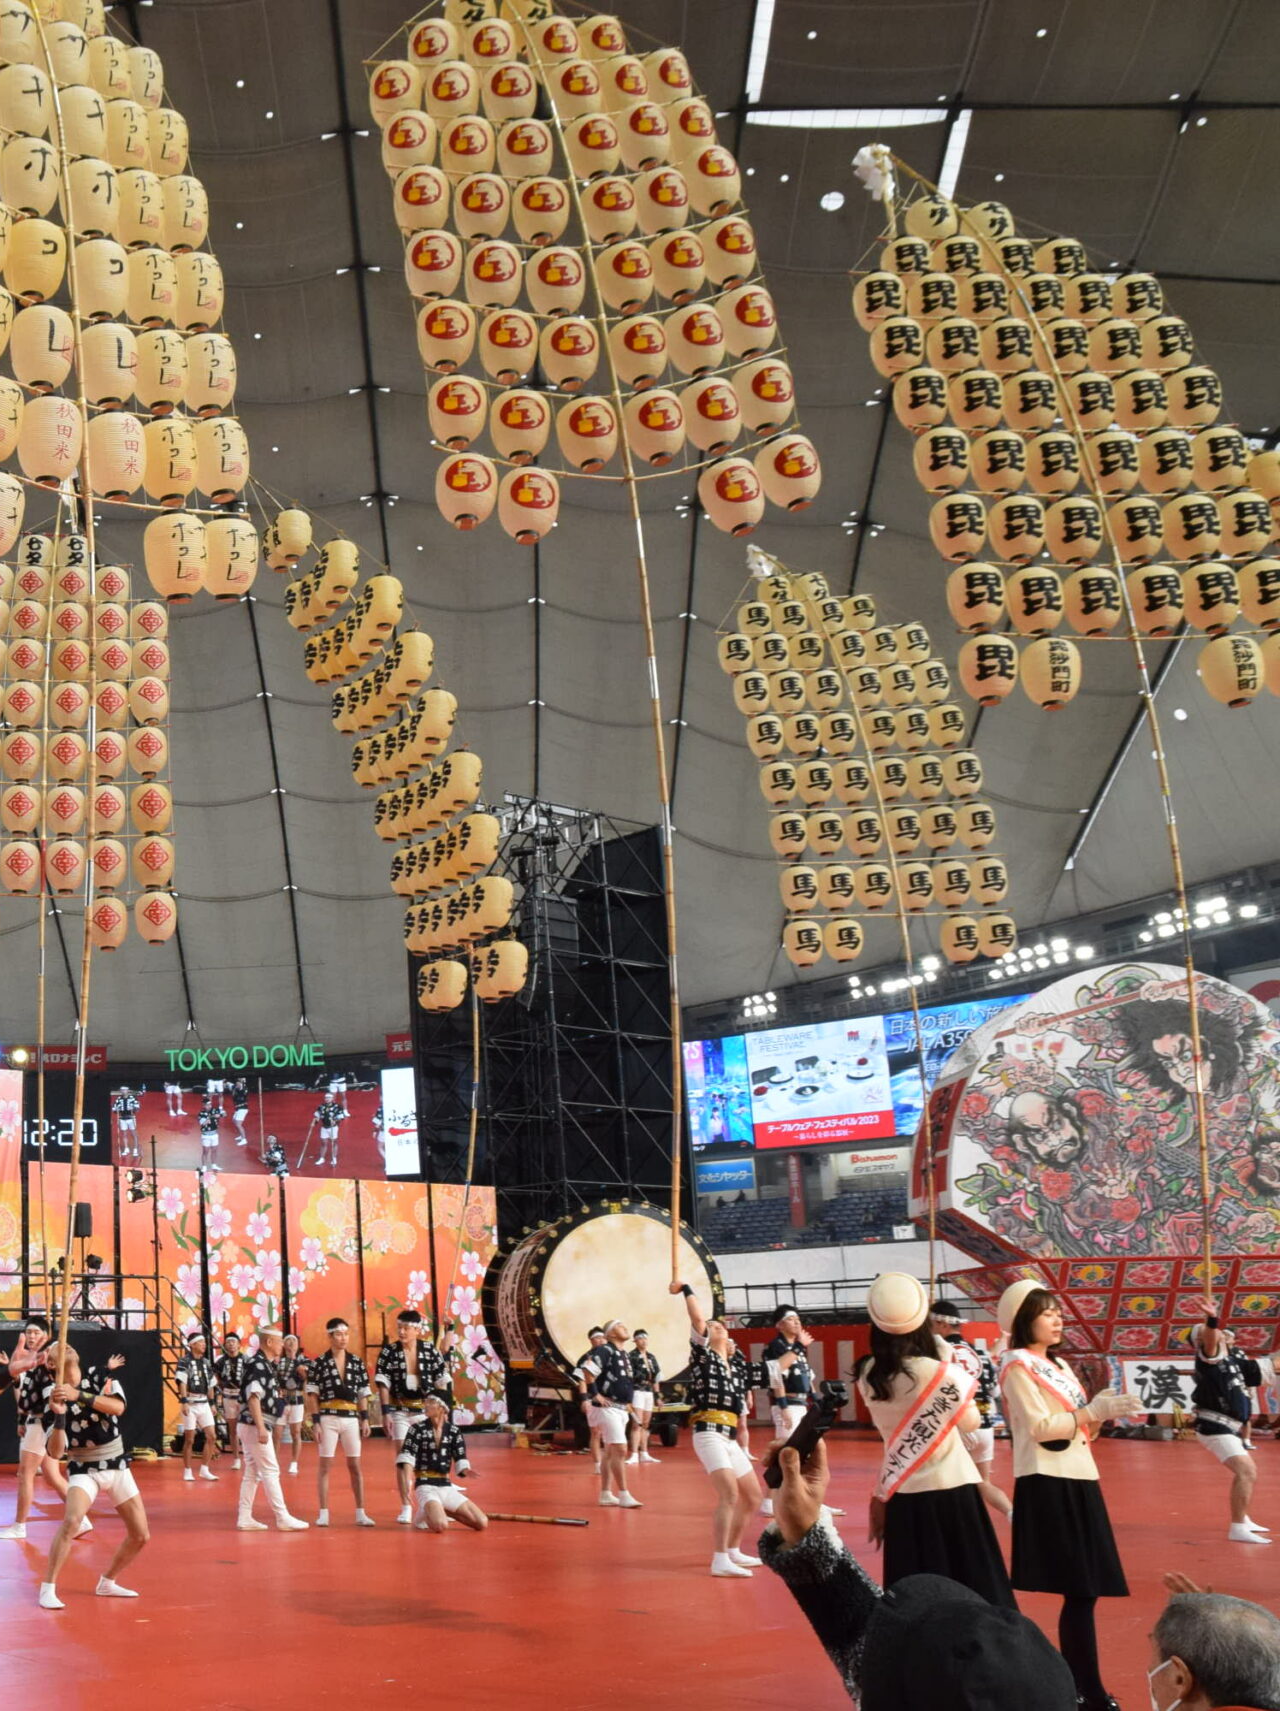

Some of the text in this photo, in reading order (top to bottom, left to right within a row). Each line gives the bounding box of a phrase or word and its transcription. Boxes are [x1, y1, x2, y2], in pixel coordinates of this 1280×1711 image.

[55, 402, 77, 461] 秋田米
[121, 418, 141, 476] 秋田米
[762, 638, 787, 662] 馬
[1048, 641, 1071, 693] 毘沙門町
[1230, 639, 1258, 691] 毘沙門町
[742, 677, 768, 701] 馬
[778, 676, 803, 700] 馬
[756, 721, 782, 745] 馬
[829, 718, 855, 742] 馬
[770, 768, 796, 791] 馬
[807, 767, 833, 792] 馬
[817, 819, 843, 842] 馬
[855, 818, 881, 843] 馬
[931, 812, 957, 836] 馬
[969, 810, 995, 835] 馬
[828, 873, 854, 898] 馬
[864, 871, 892, 896] 馬
[980, 866, 1006, 892] 馬
[795, 928, 821, 953] 馬
[836, 926, 860, 950] 馬
[953, 925, 978, 951] 馬
[989, 923, 1015, 947] 馬
[752, 1031, 812, 1045] TABLEWARE
[164, 1043, 326, 1072] TOKYO DOME
[23, 1118, 98, 1146] 12:20
[1134, 1364, 1187, 1410] 漢
